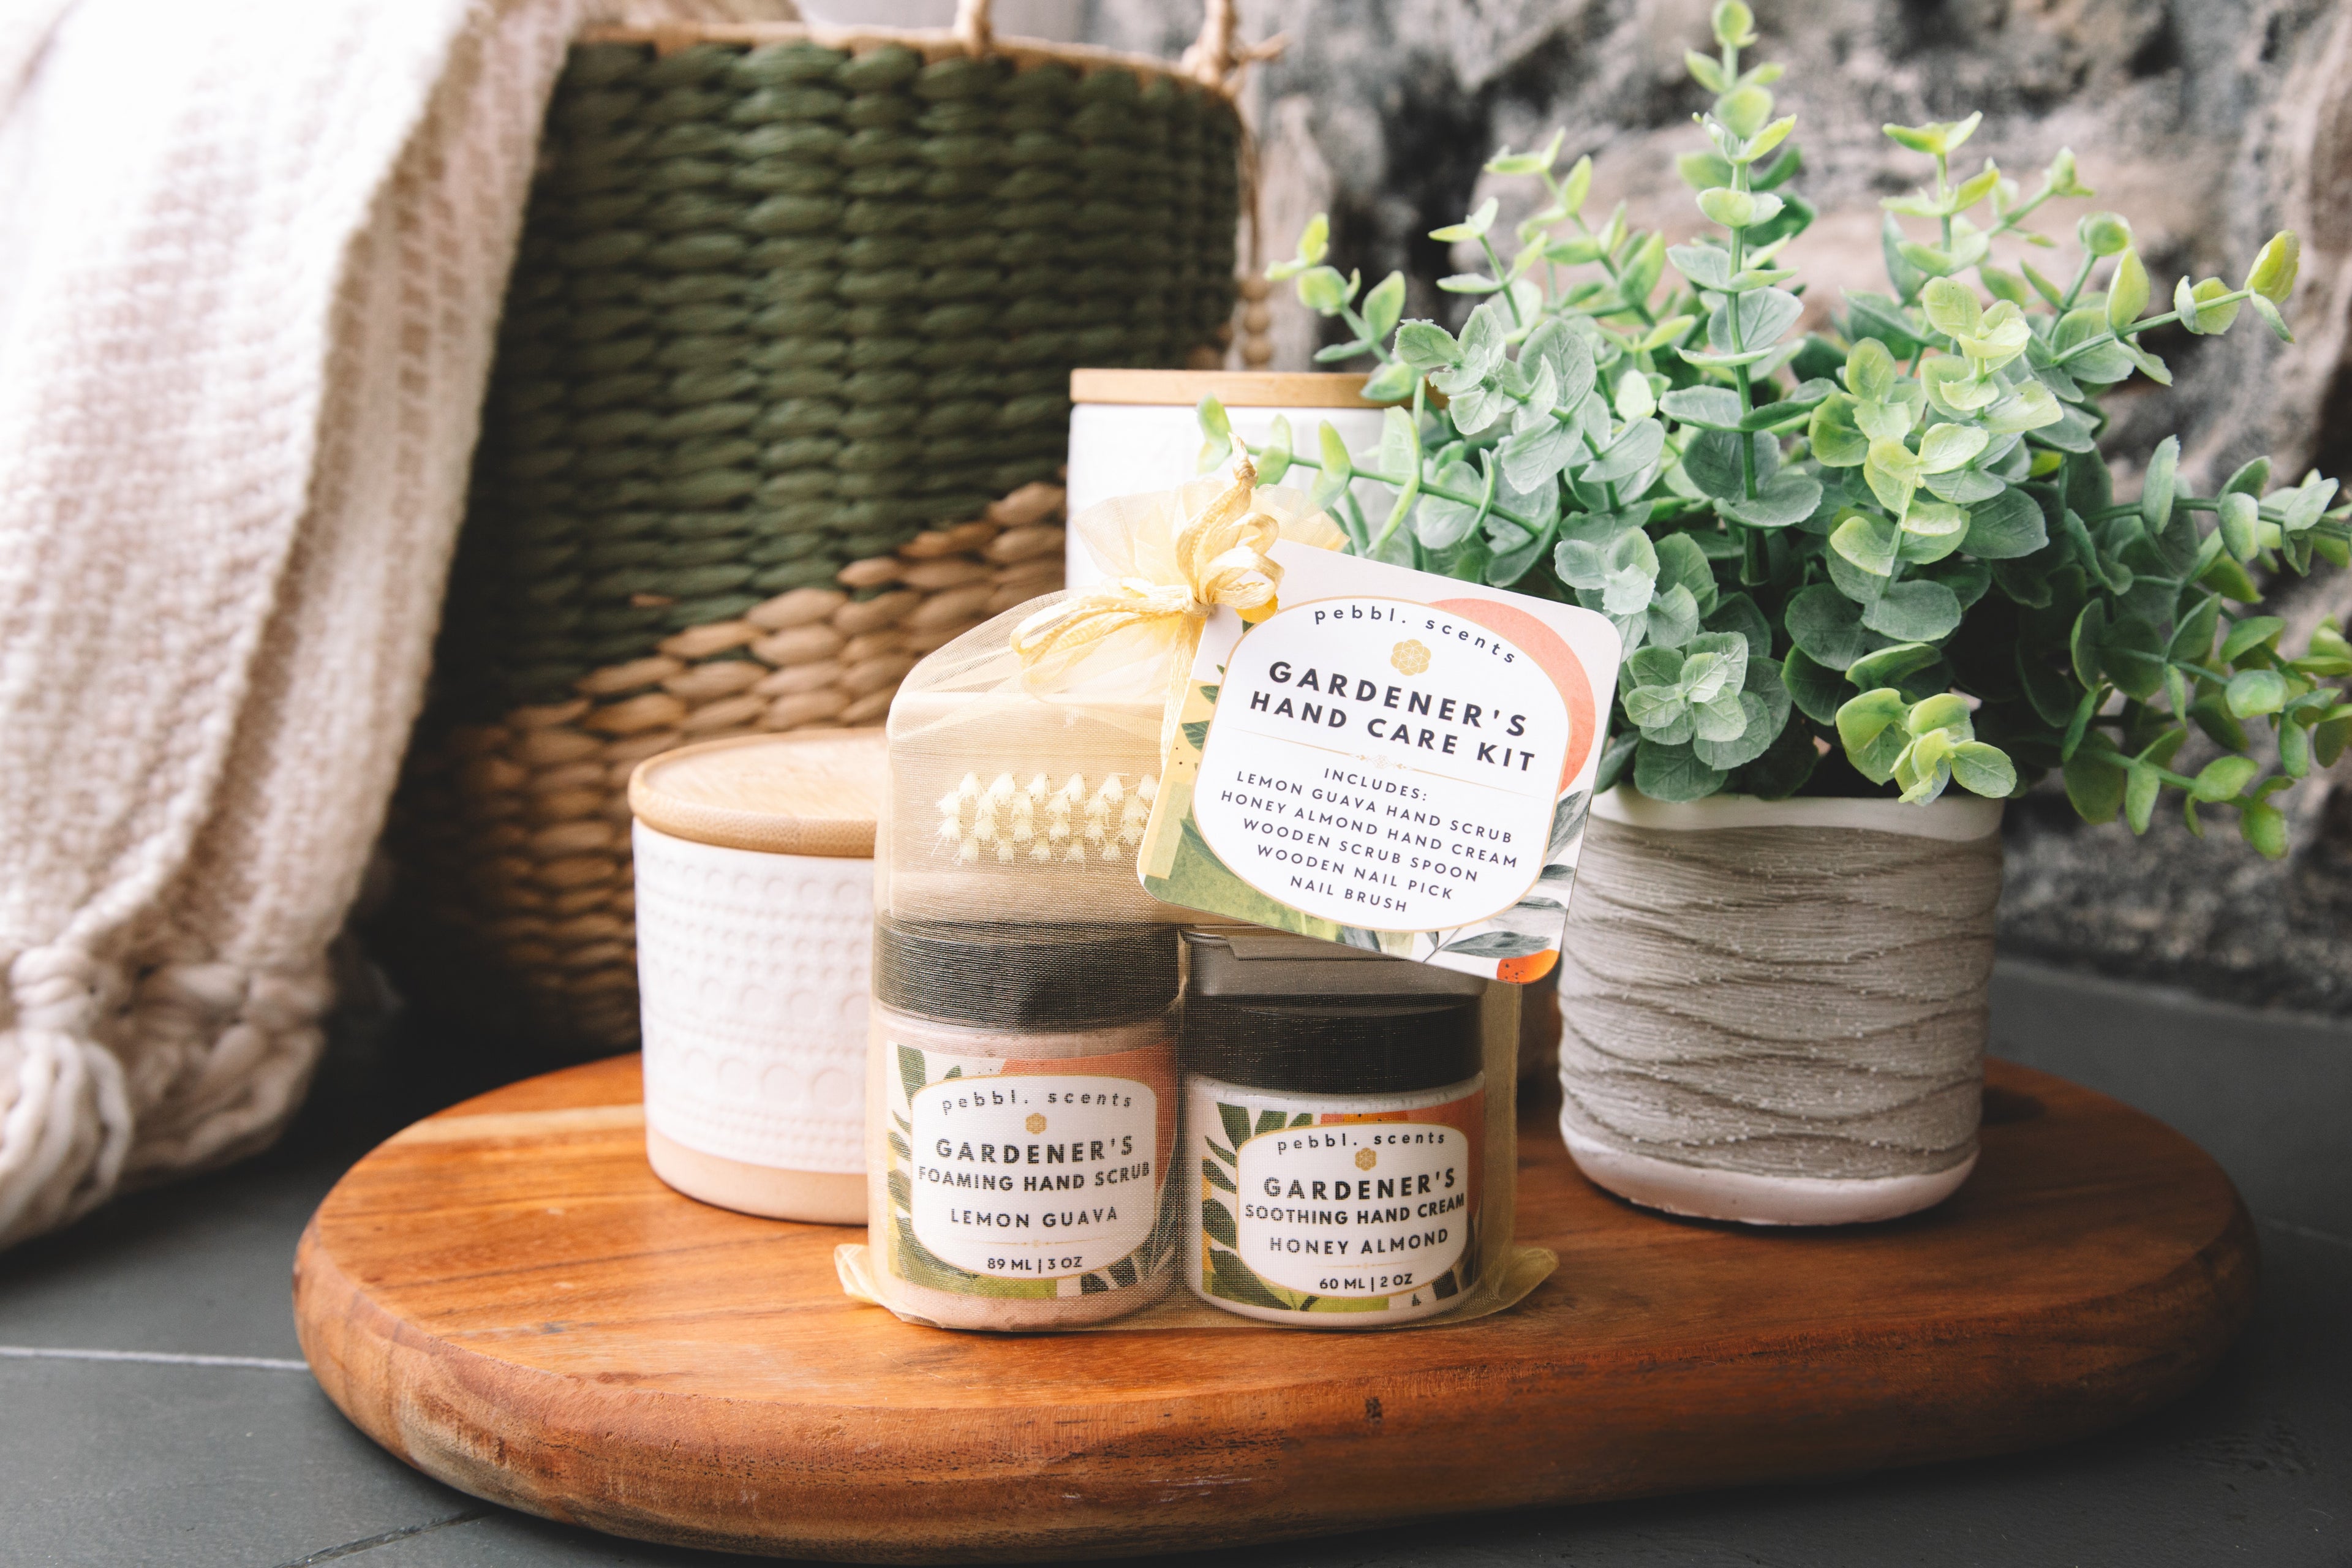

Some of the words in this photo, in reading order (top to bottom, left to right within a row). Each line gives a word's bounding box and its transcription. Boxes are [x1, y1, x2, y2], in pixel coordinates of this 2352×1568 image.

[1315, 605, 1405, 625] pebbl.
[1426, 620, 1514, 663] scents
[1270, 662, 1526, 736] GARDENER'S
[1251, 691, 1346, 728] HAND
[1368, 718, 1457, 754] CARE
[1477, 742, 1534, 771] KIT
[1325, 768, 1426, 801] INCLUDES:
[1237, 771, 1302, 795] LEMON
[1313, 789, 1375, 812] GUAVA
[1387, 805, 1440, 826] HAND
[1450, 820, 1511, 843] SCRUB
[1221, 791, 1286, 813] HONEY
[1294, 808, 1377, 834] ALMOND
[1388, 829, 1441, 849] HAND
[1452, 844, 1517, 867] CREAM
[1245, 818, 1329, 847] WOODEN
[1340, 841, 1400, 863] SCRUB
[1411, 858, 1477, 881] SPOON
[1258, 845, 1344, 874] WOODEN
[1354, 867, 1396, 886] NAIL
[1408, 880, 1452, 899] PICK
[1291, 876, 1333, 895] NAIL
[1345, 889, 1406, 911] BRUSH
[942, 1090, 1029, 1115] pebbl.
[1049, 1093, 1132, 1109] scents
[936, 1135, 1134, 1164] GARDENER'S
[1278, 1133, 1357, 1154] pebbl.
[1374, 1131, 1445, 1145] scents
[919, 1166, 1014, 1191] FOAMING
[1024, 1174, 1085, 1191] HAND
[1095, 1162, 1150, 1186] SCRUB
[1264, 1168, 1455, 1200] GARDENER'S
[951, 1208, 1029, 1228] LEMON
[1042, 1207, 1117, 1227] GUAVA
[1245, 1204, 1348, 1225] SOOTHING
[1357, 1207, 1411, 1223] HAND
[1418, 1193, 1464, 1218] CREAM
[1270, 1237, 1349, 1255] HONEY
[1361, 1228, 1449, 1254] ALMOND
[987, 1257, 1006, 1269] 89
[1011, 1259, 1031, 1270] ML
[1048, 1258, 1056, 1270] 3
[1061, 1256, 1082, 1268] OZ
[1319, 1278, 1339, 1290] 60
[1344, 1279, 1365, 1289] ML
[1380, 1276, 1388, 1288] 2
[1393, 1273, 1412, 1286] OZ
